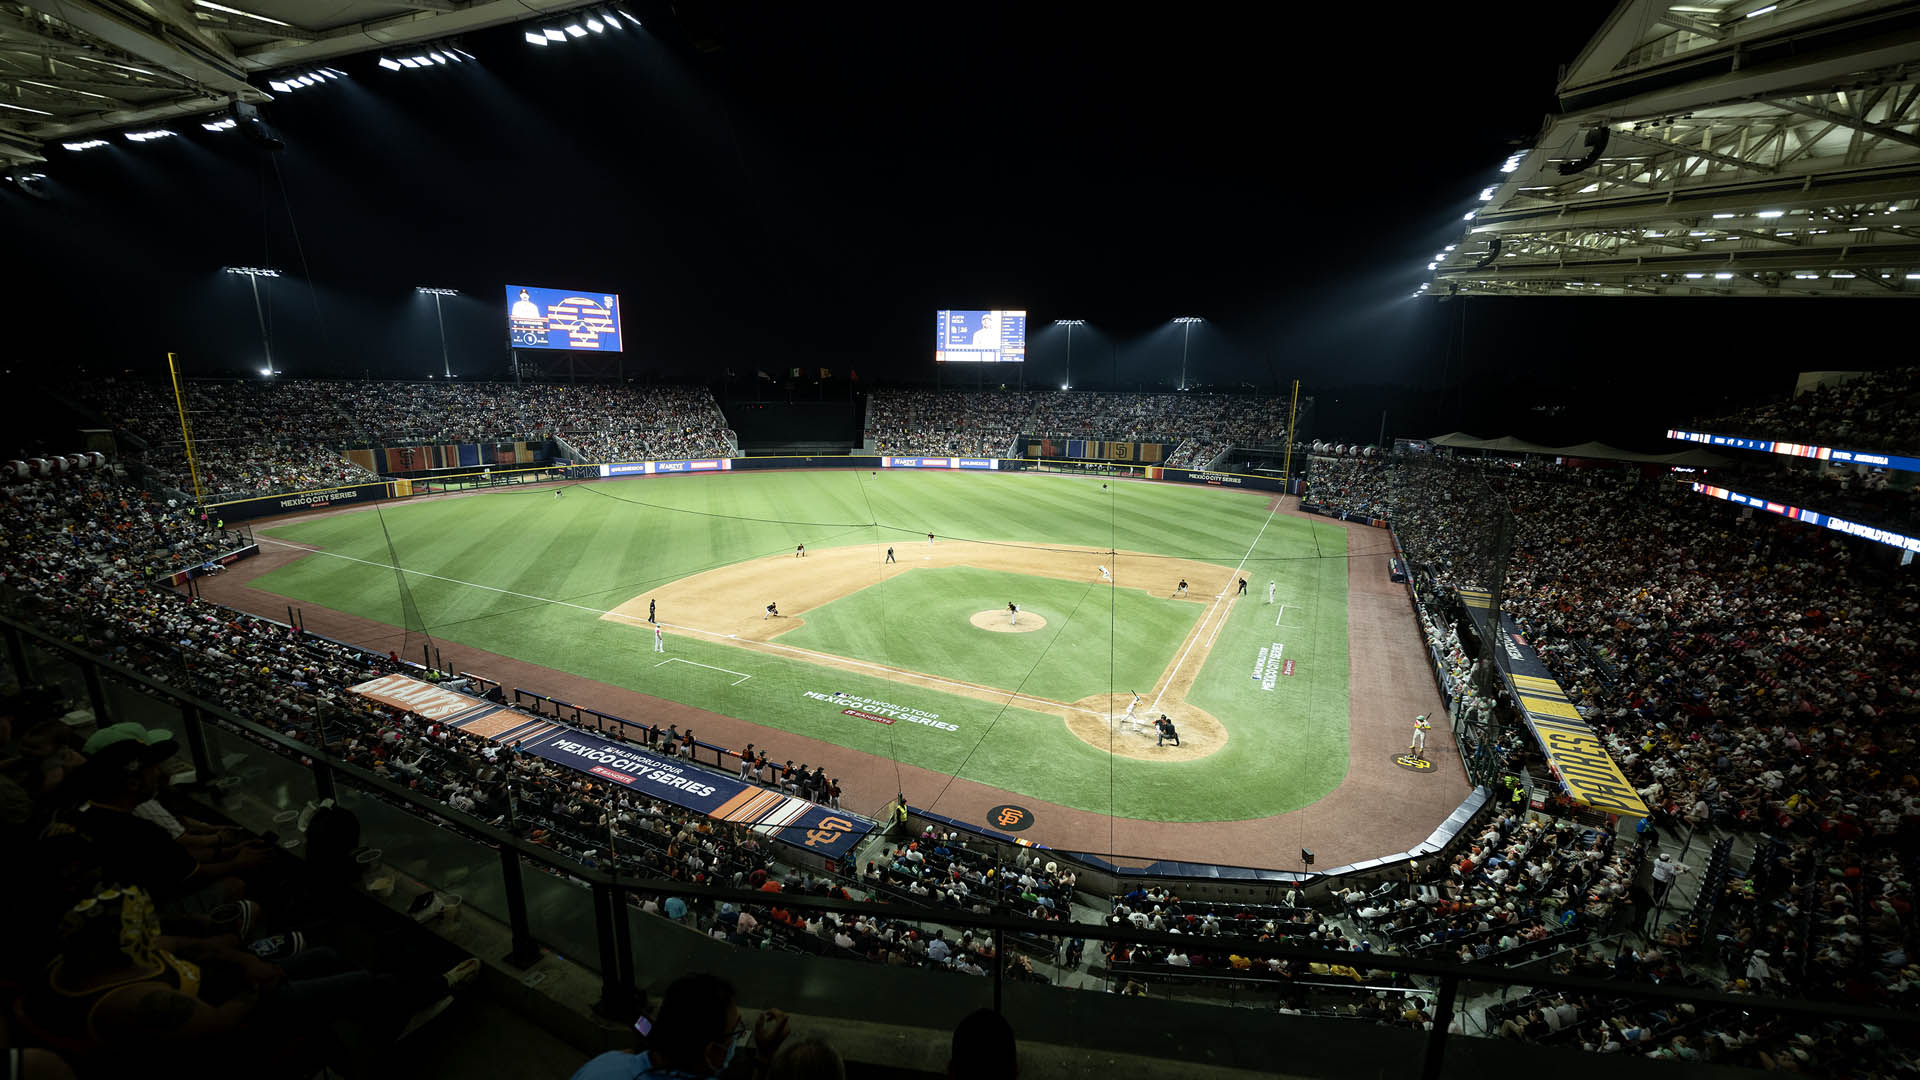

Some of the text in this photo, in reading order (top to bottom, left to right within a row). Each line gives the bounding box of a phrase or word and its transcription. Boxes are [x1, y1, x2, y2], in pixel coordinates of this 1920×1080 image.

[280, 498, 312, 508] MEXICO
[312, 494, 329, 505] CITY
[330, 491, 357, 501] SERIES
[802, 691, 960, 732] MEXICO CITY SERIES
[850, 694, 940, 720] MLB WORLD TOUR
[551, 739, 716, 797] MEXICO CITY SERIES
[613, 749, 684, 775] MLB WORLD TOUR
[1549, 733, 1650, 815] PADRES
[997, 807, 1024, 826] SF
